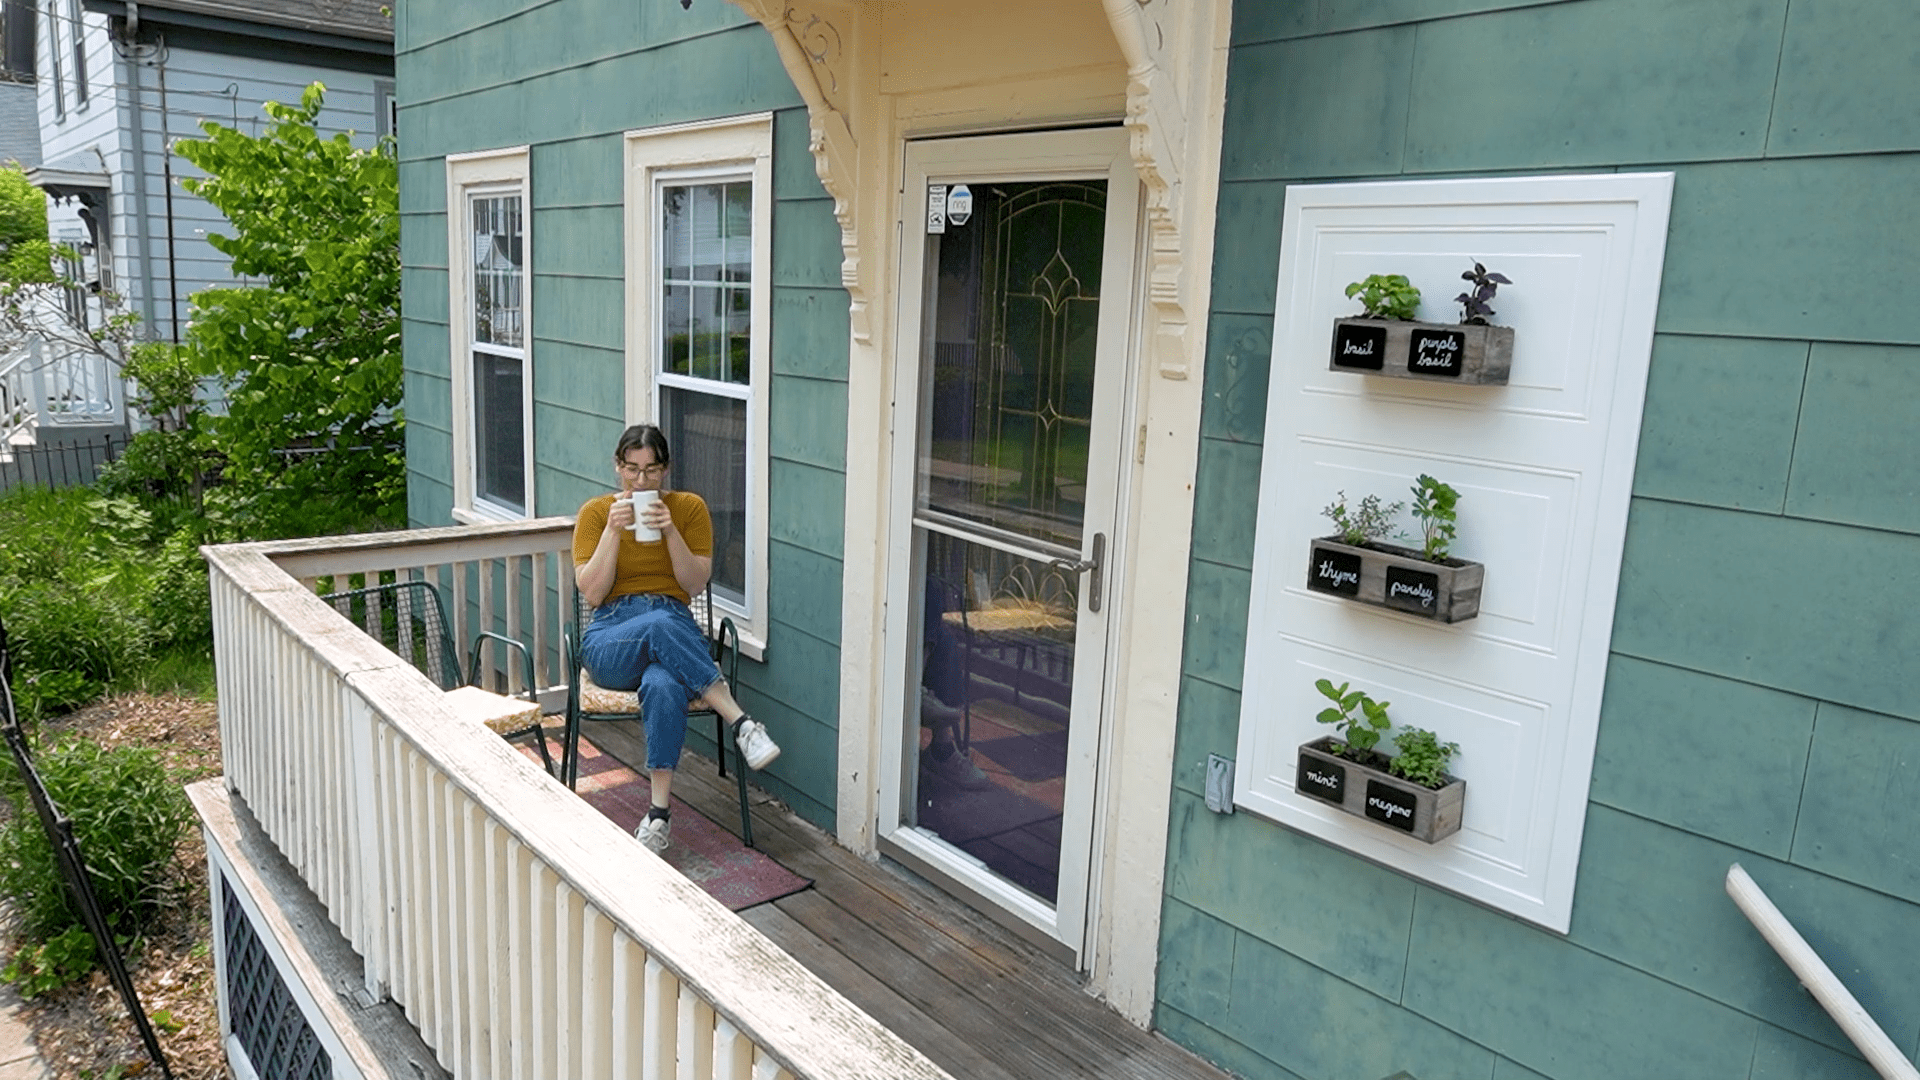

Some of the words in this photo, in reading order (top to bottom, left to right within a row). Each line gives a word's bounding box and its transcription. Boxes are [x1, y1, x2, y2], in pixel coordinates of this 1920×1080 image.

[1343, 339, 1373, 355] basil
[1418, 335, 1458, 354] purple
[1416, 352, 1452, 367] basil
[1319, 560, 1358, 587] thyme
[1390, 581, 1434, 608] parsley
[1306, 771, 1338, 789] mint
[1368, 797, 1412, 818] oregano
